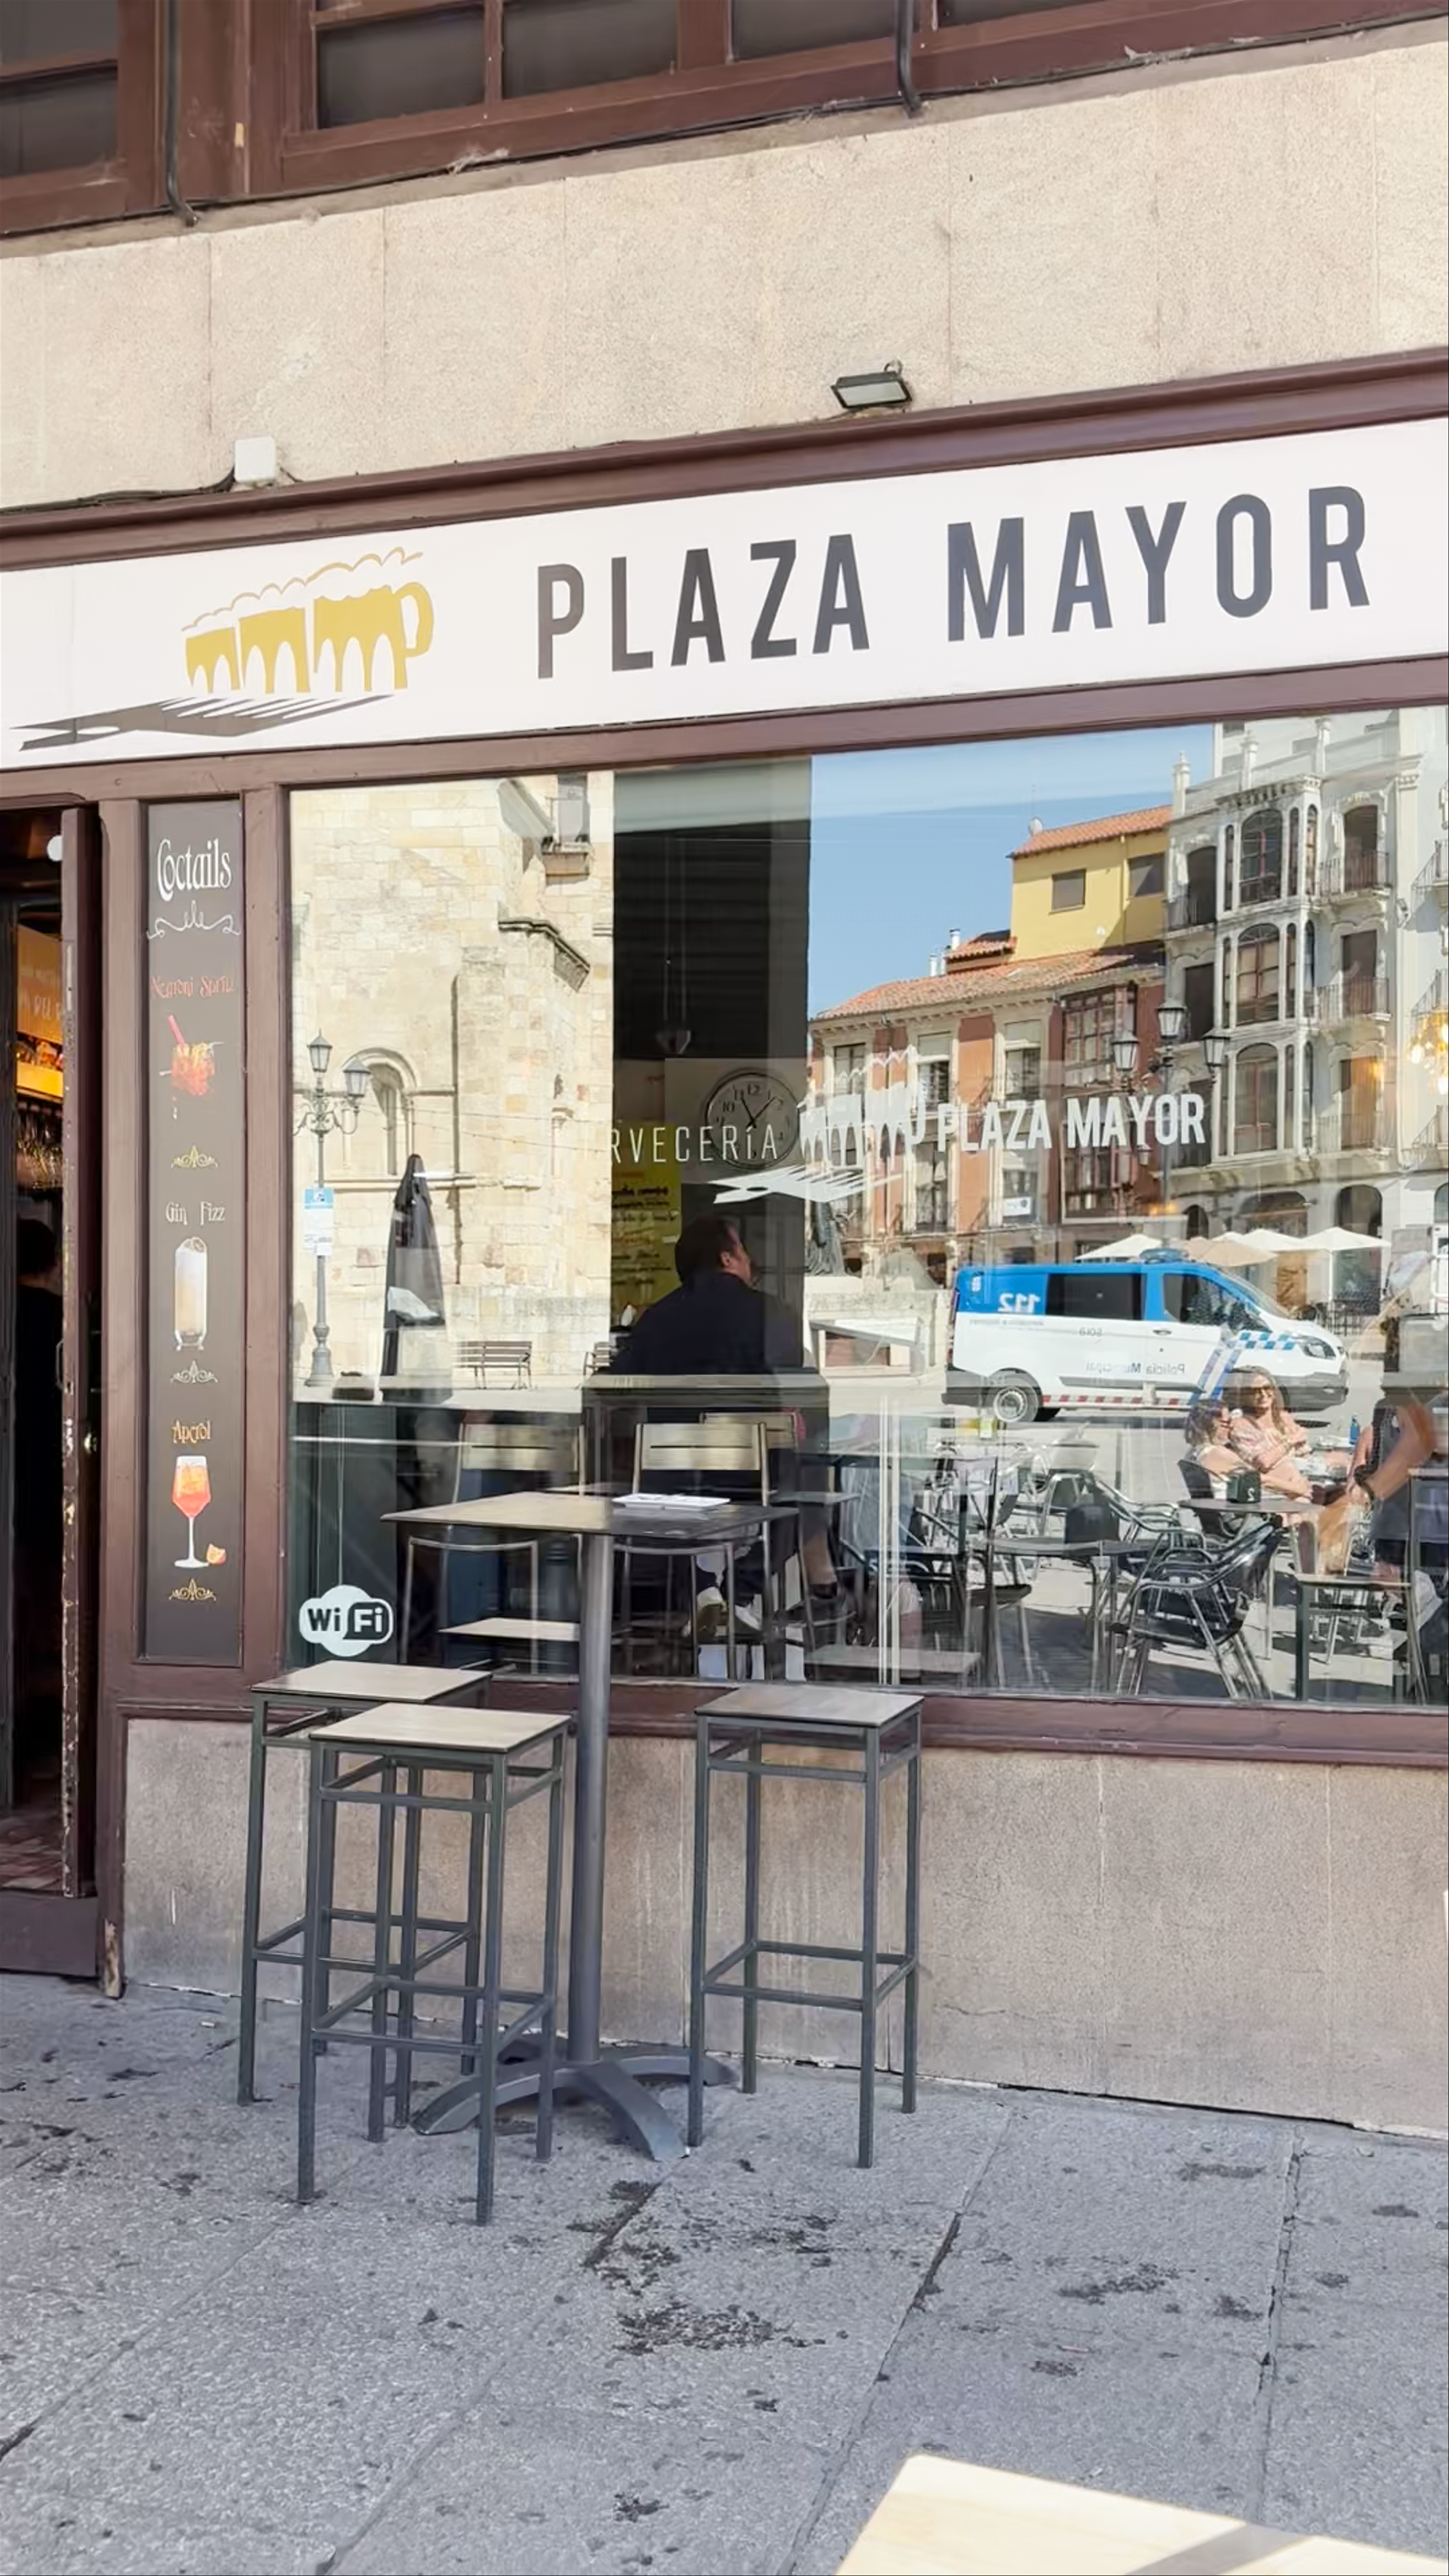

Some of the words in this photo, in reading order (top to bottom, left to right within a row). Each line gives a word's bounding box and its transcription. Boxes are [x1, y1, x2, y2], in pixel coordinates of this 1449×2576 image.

[538, 534, 869, 679] PLAZA
[948, 485, 1370, 642] MAYOR
[157, 838, 232, 901] Coctails
[938, 1099, 1052, 1152] PLAZA
[1067, 1093, 1206, 1149] MAYOR
[165, 1201, 188, 1226] Gin
[200, 1201, 225, 1226] Fizz
[171, 1419, 211, 1444] Aperol
